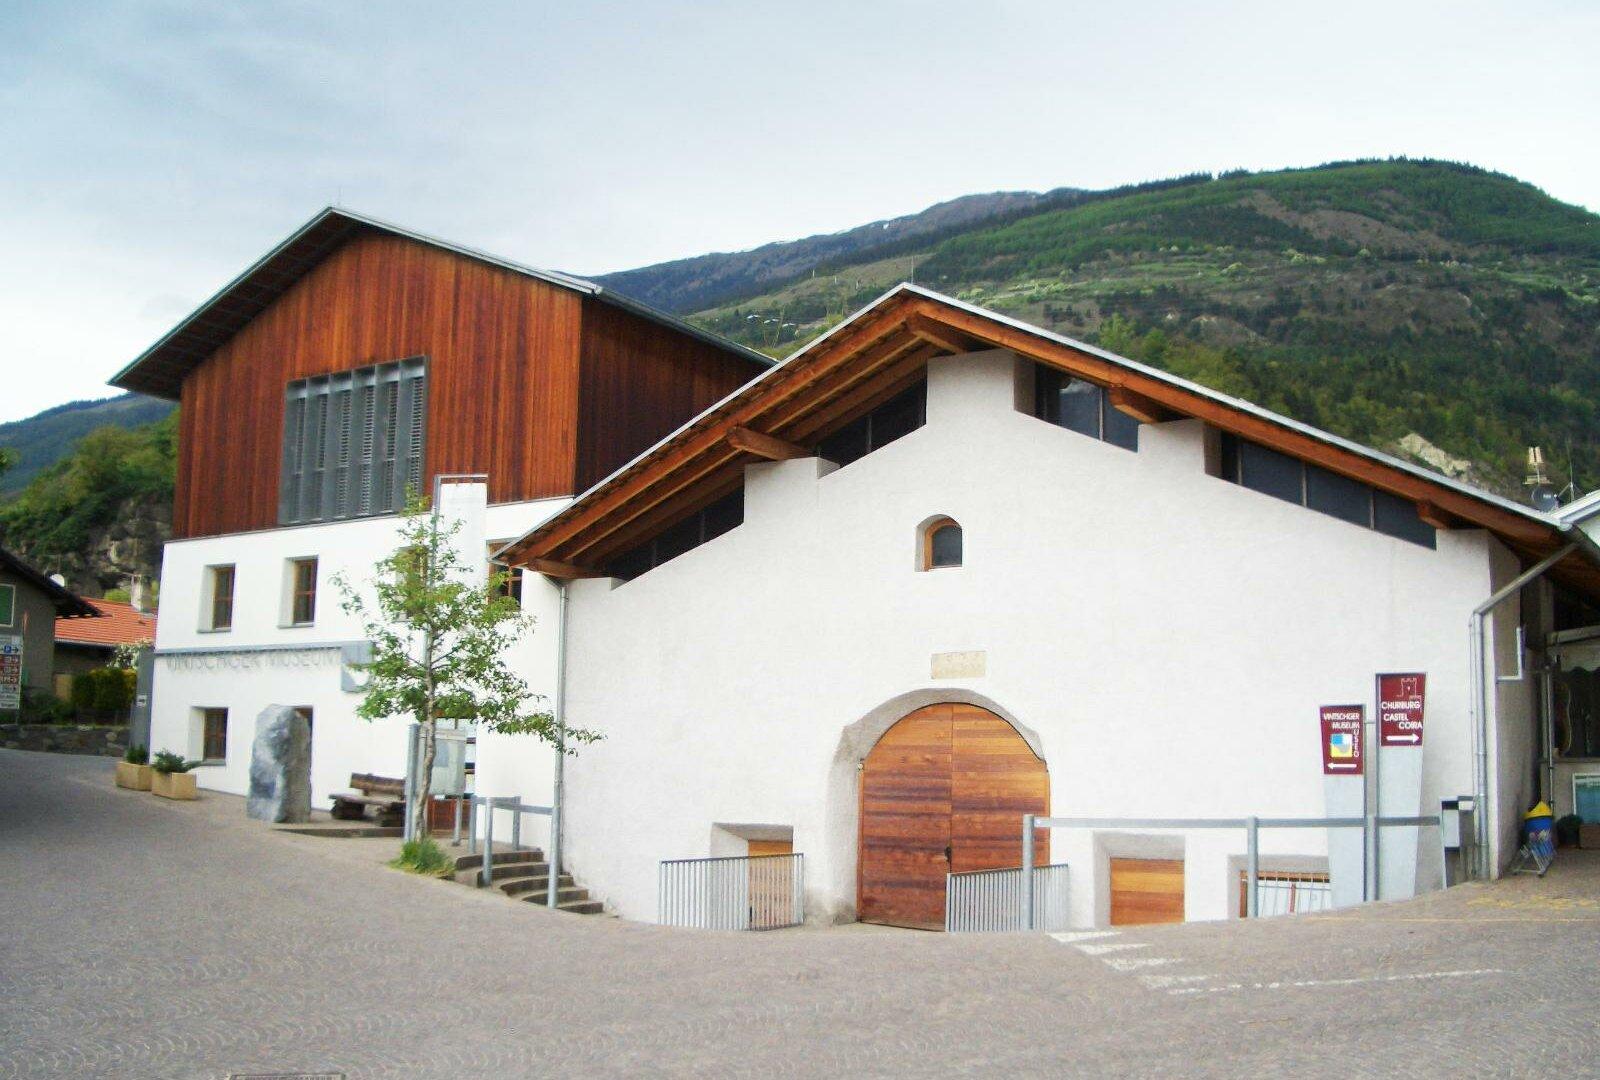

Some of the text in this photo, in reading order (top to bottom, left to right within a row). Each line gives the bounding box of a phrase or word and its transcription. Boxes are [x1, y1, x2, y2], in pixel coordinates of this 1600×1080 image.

[266, 650, 337, 668] MUSEUM
[1381, 700, 1420, 710] CHURBURG
[1324, 712, 1360, 721] VINTSCHGER
[1383, 713, 1409, 722] CASTEL
[1332, 721, 1360, 730] MUSEUM
[1398, 721, 1423, 730] COIRA
